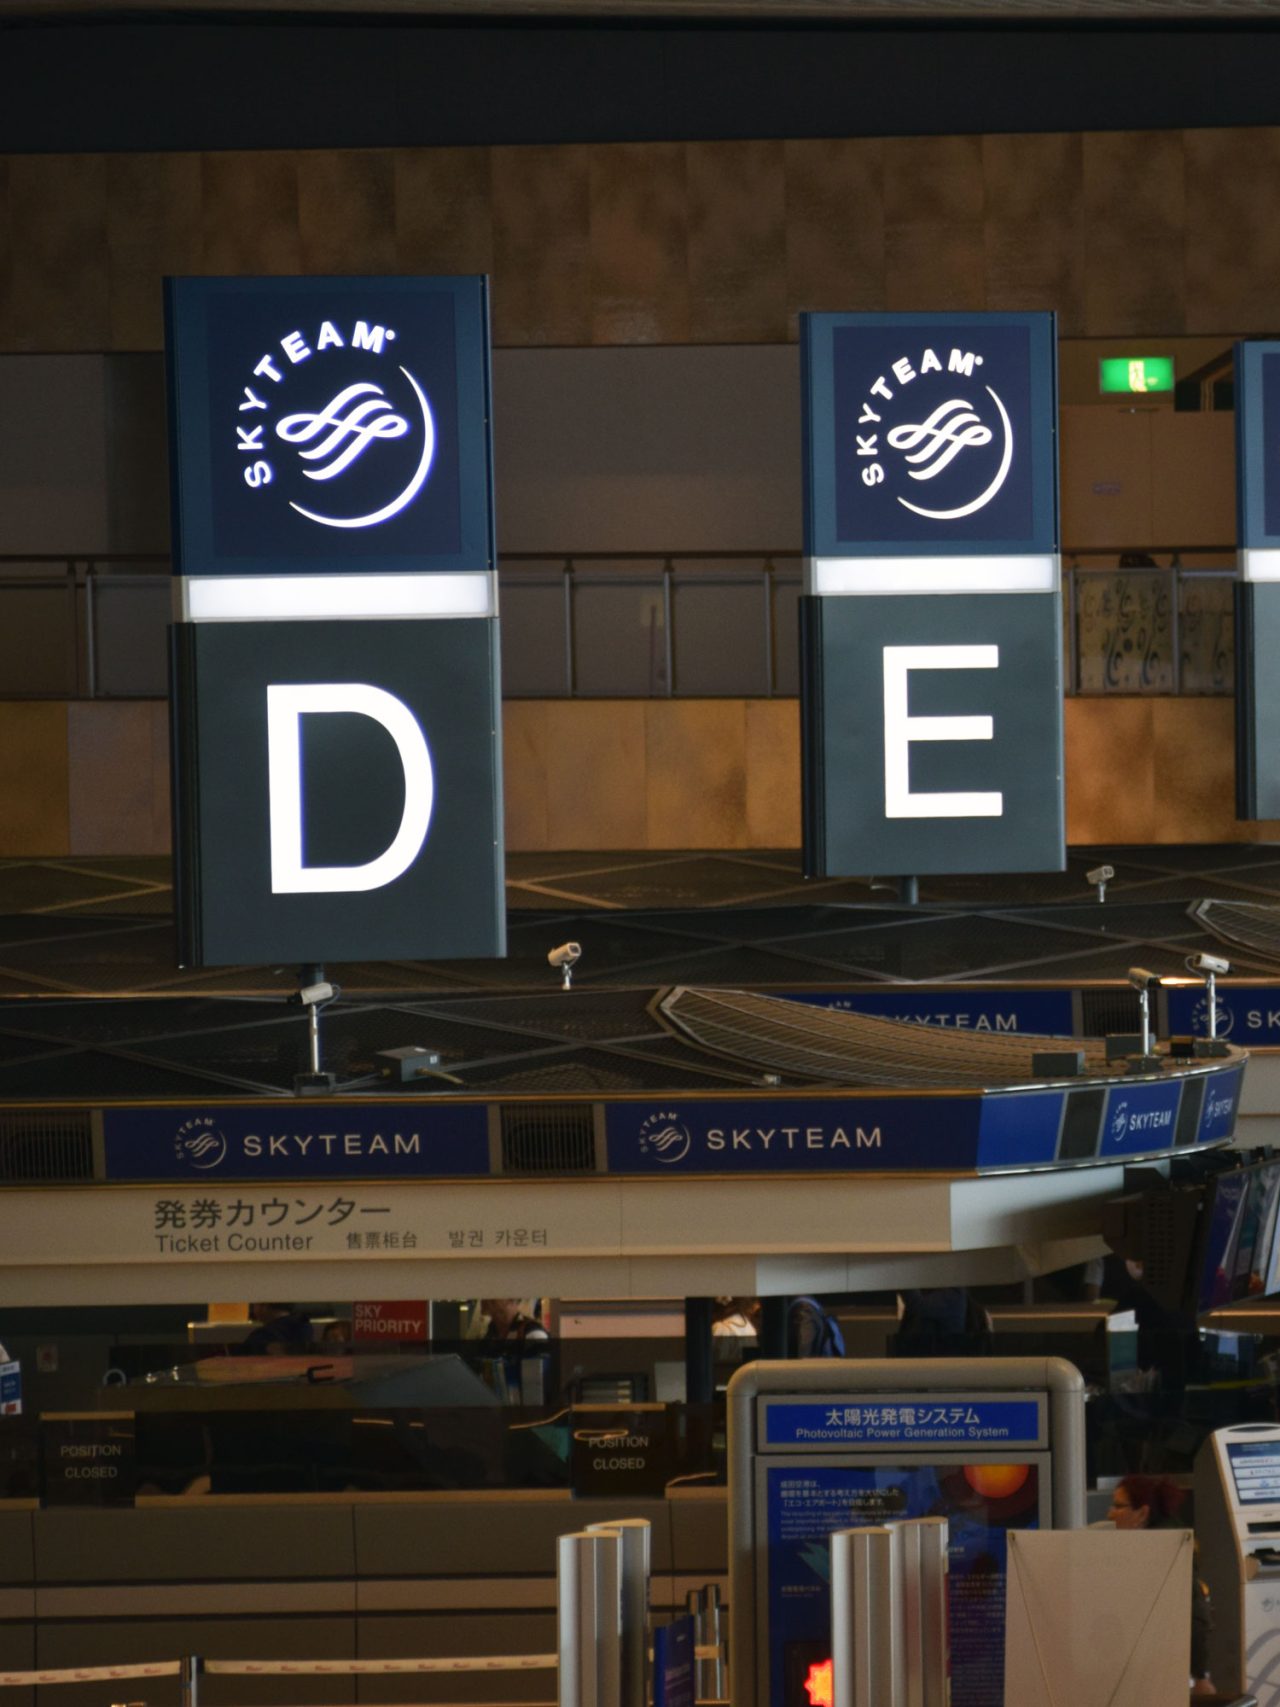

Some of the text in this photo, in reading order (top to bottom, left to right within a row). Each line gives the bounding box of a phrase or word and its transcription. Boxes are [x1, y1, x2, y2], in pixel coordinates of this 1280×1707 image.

[237, 319, 387, 489] SKYTEAM
[856, 347, 976, 487] SKYTEAM
[883, 645, 1002, 818] E
[267, 684, 433, 893] D
[1129, 1109, 1172, 1131] SKYTEAM
[243, 1133, 421, 1157] SKYTEAM
[707, 1127, 882, 1151] SKYTEAM
[154, 1197, 392, 1230] 発券カウンター
[155, 1229, 548, 1253] Ticket Counter 售票柜台 발권 카운터
[355, 1304, 382, 1318] SKY
[355, 1319, 421, 1333] PRIORITY
[826, 1407, 980, 1426] 太陽光発電システム
[588, 1436, 649, 1448] POSITION
[796, 1426, 1009, 1439] Photovoltaic Power Generation System
[61, 1444, 121, 1457] POSITION
[64, 1467, 118, 1479] CLOSED
[593, 1458, 645, 1470] CLOSED
